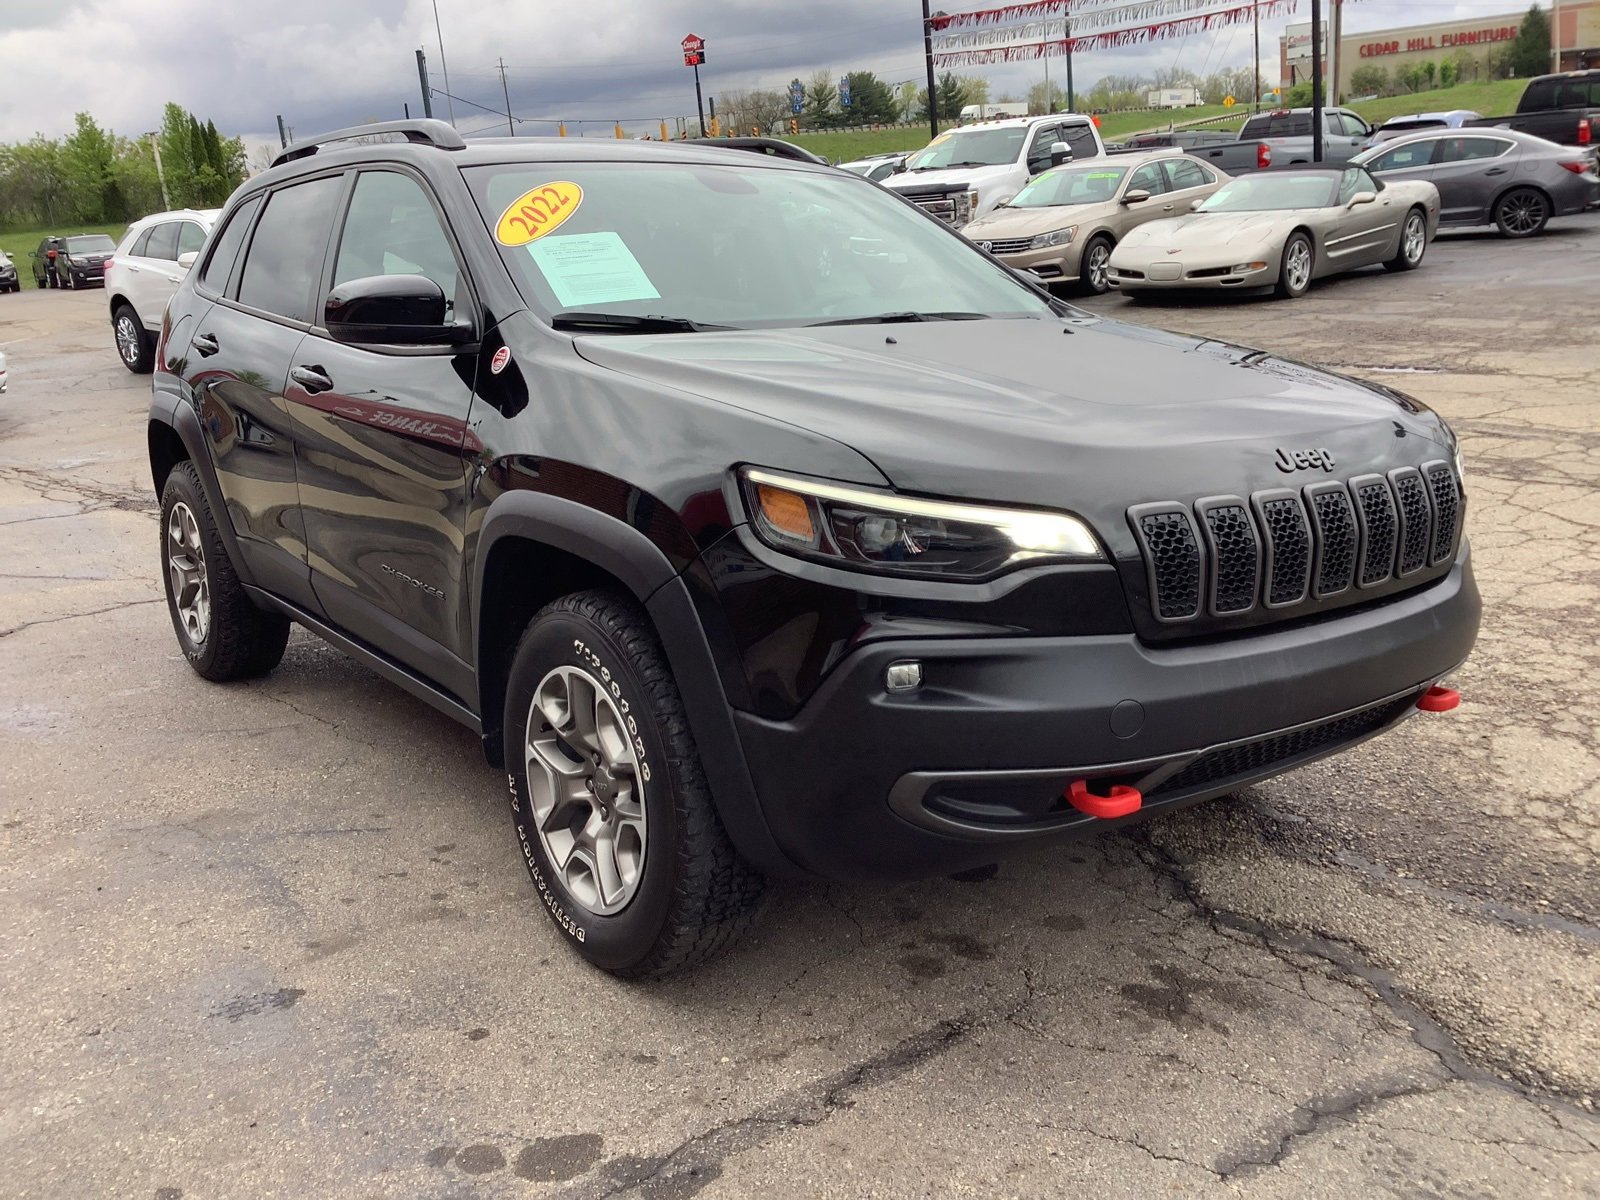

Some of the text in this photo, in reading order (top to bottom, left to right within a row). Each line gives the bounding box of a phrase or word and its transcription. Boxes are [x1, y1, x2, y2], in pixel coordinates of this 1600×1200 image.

[1359, 25, 1518, 58] CEDAR HILL FURNITURE
[509, 187, 570, 237] 2022
[1275, 447, 1336, 473] Jeep
[518, 824, 586, 942] DESTINATION
